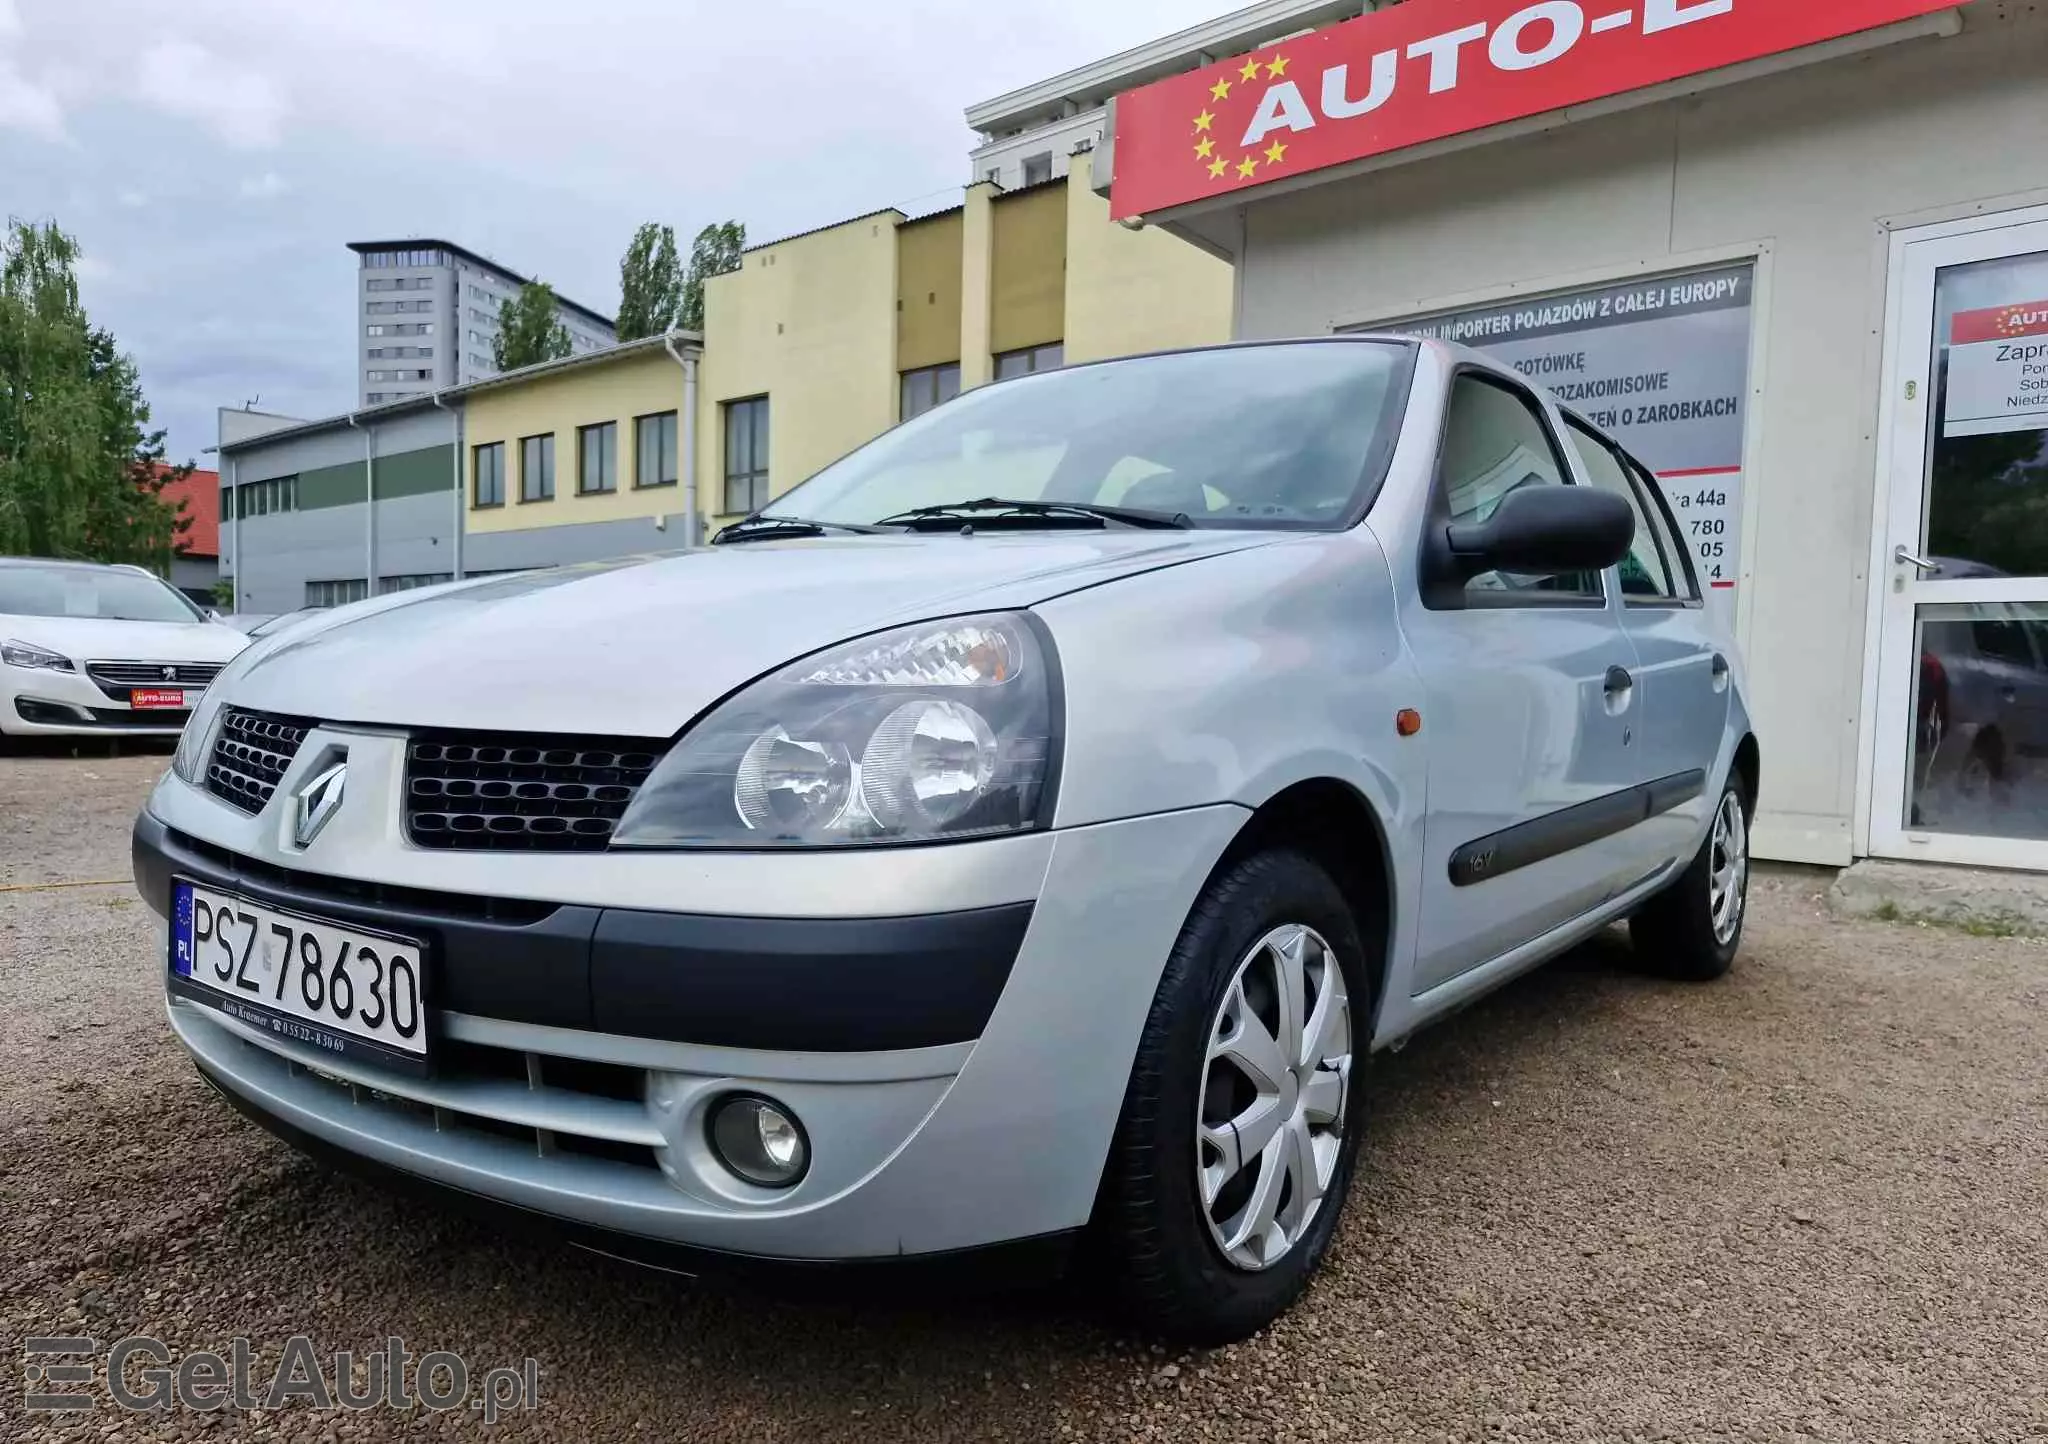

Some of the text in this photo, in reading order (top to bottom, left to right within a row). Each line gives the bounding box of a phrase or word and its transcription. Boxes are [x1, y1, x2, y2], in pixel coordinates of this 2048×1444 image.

[1441, 314, 1511, 341] IMPORTER
[1515, 298, 1596, 331] POJAZDÓW
[1600, 298, 1611, 317] Z
[1614, 289, 1665, 314] CAŁEJ
[1670, 277, 1739, 306] EUROPY
[1996, 344, 2048, 362] Zapr
[1622, 409, 1632, 425] O
[1637, 397, 1737, 424] ZAROBKACH
[1696, 488, 1726, 506] 44a
[1691, 519, 1725, 536] 780
[1697, 542, 1723, 558] 05
[178, 940, 190, 961] PL
[194, 898, 418, 1039] PSZ 78630
